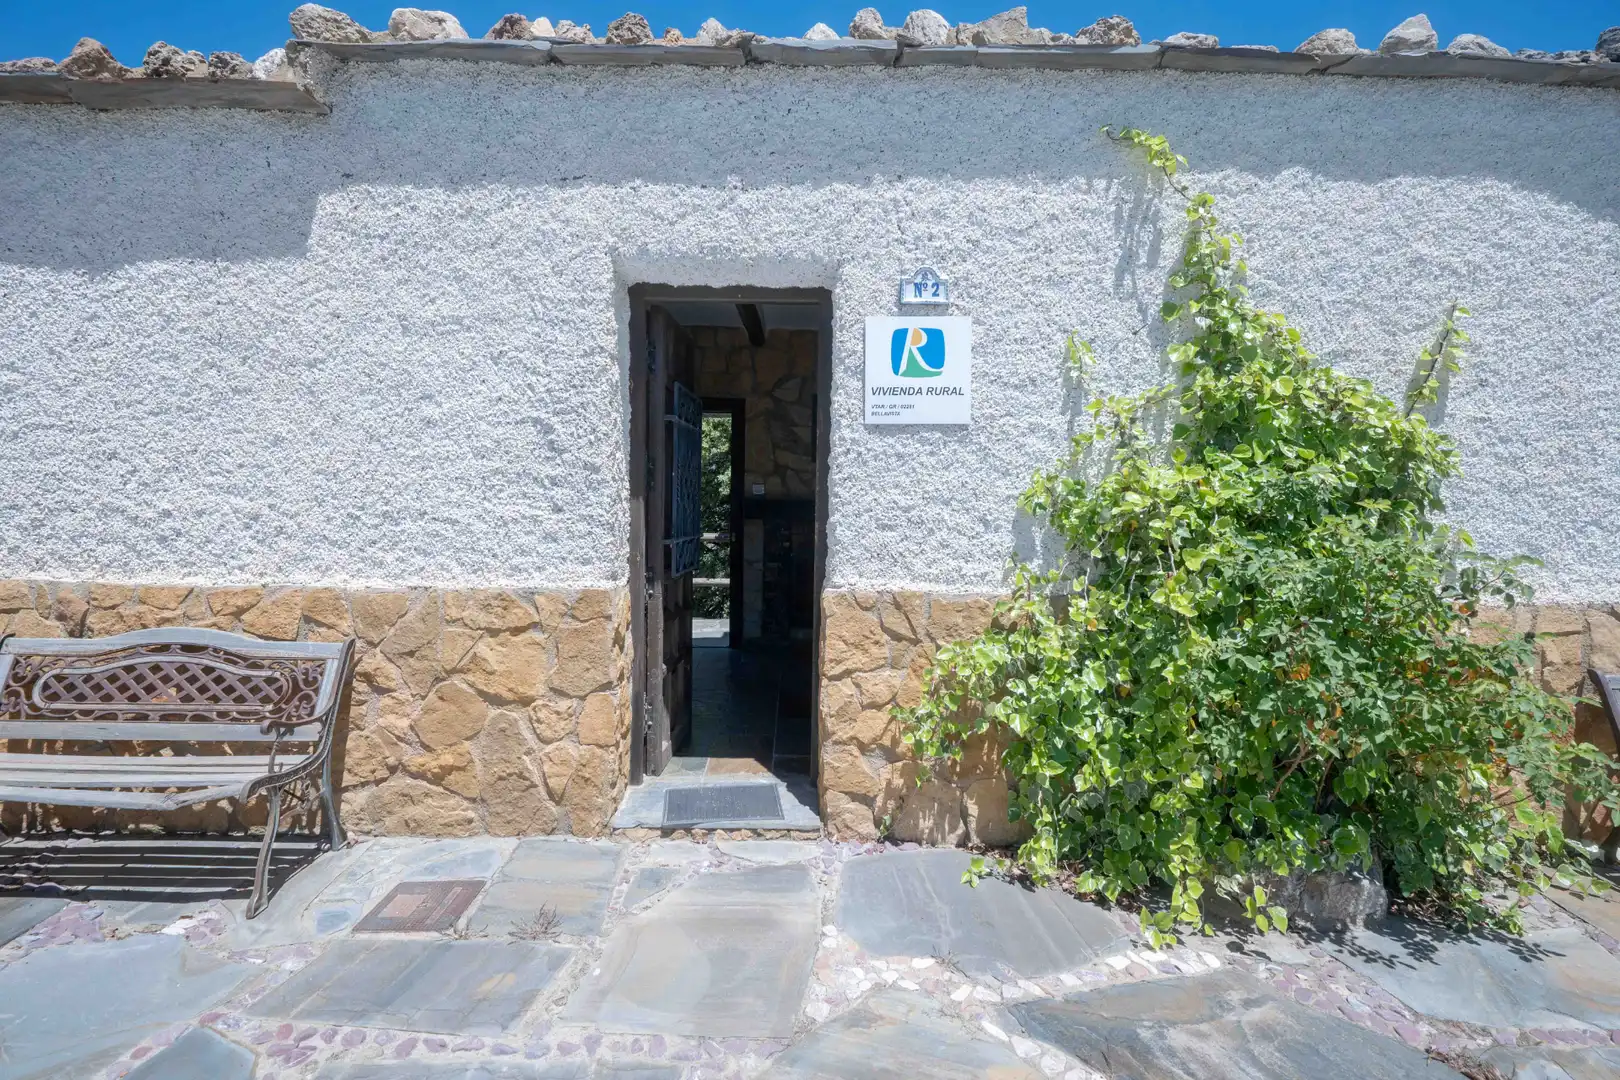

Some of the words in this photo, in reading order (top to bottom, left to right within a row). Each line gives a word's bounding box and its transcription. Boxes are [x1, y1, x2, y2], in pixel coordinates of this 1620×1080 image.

[931, 282, 940, 297] 2
[871, 386, 923, 396] VIVIENDA
[925, 386, 965, 396] RURAL
